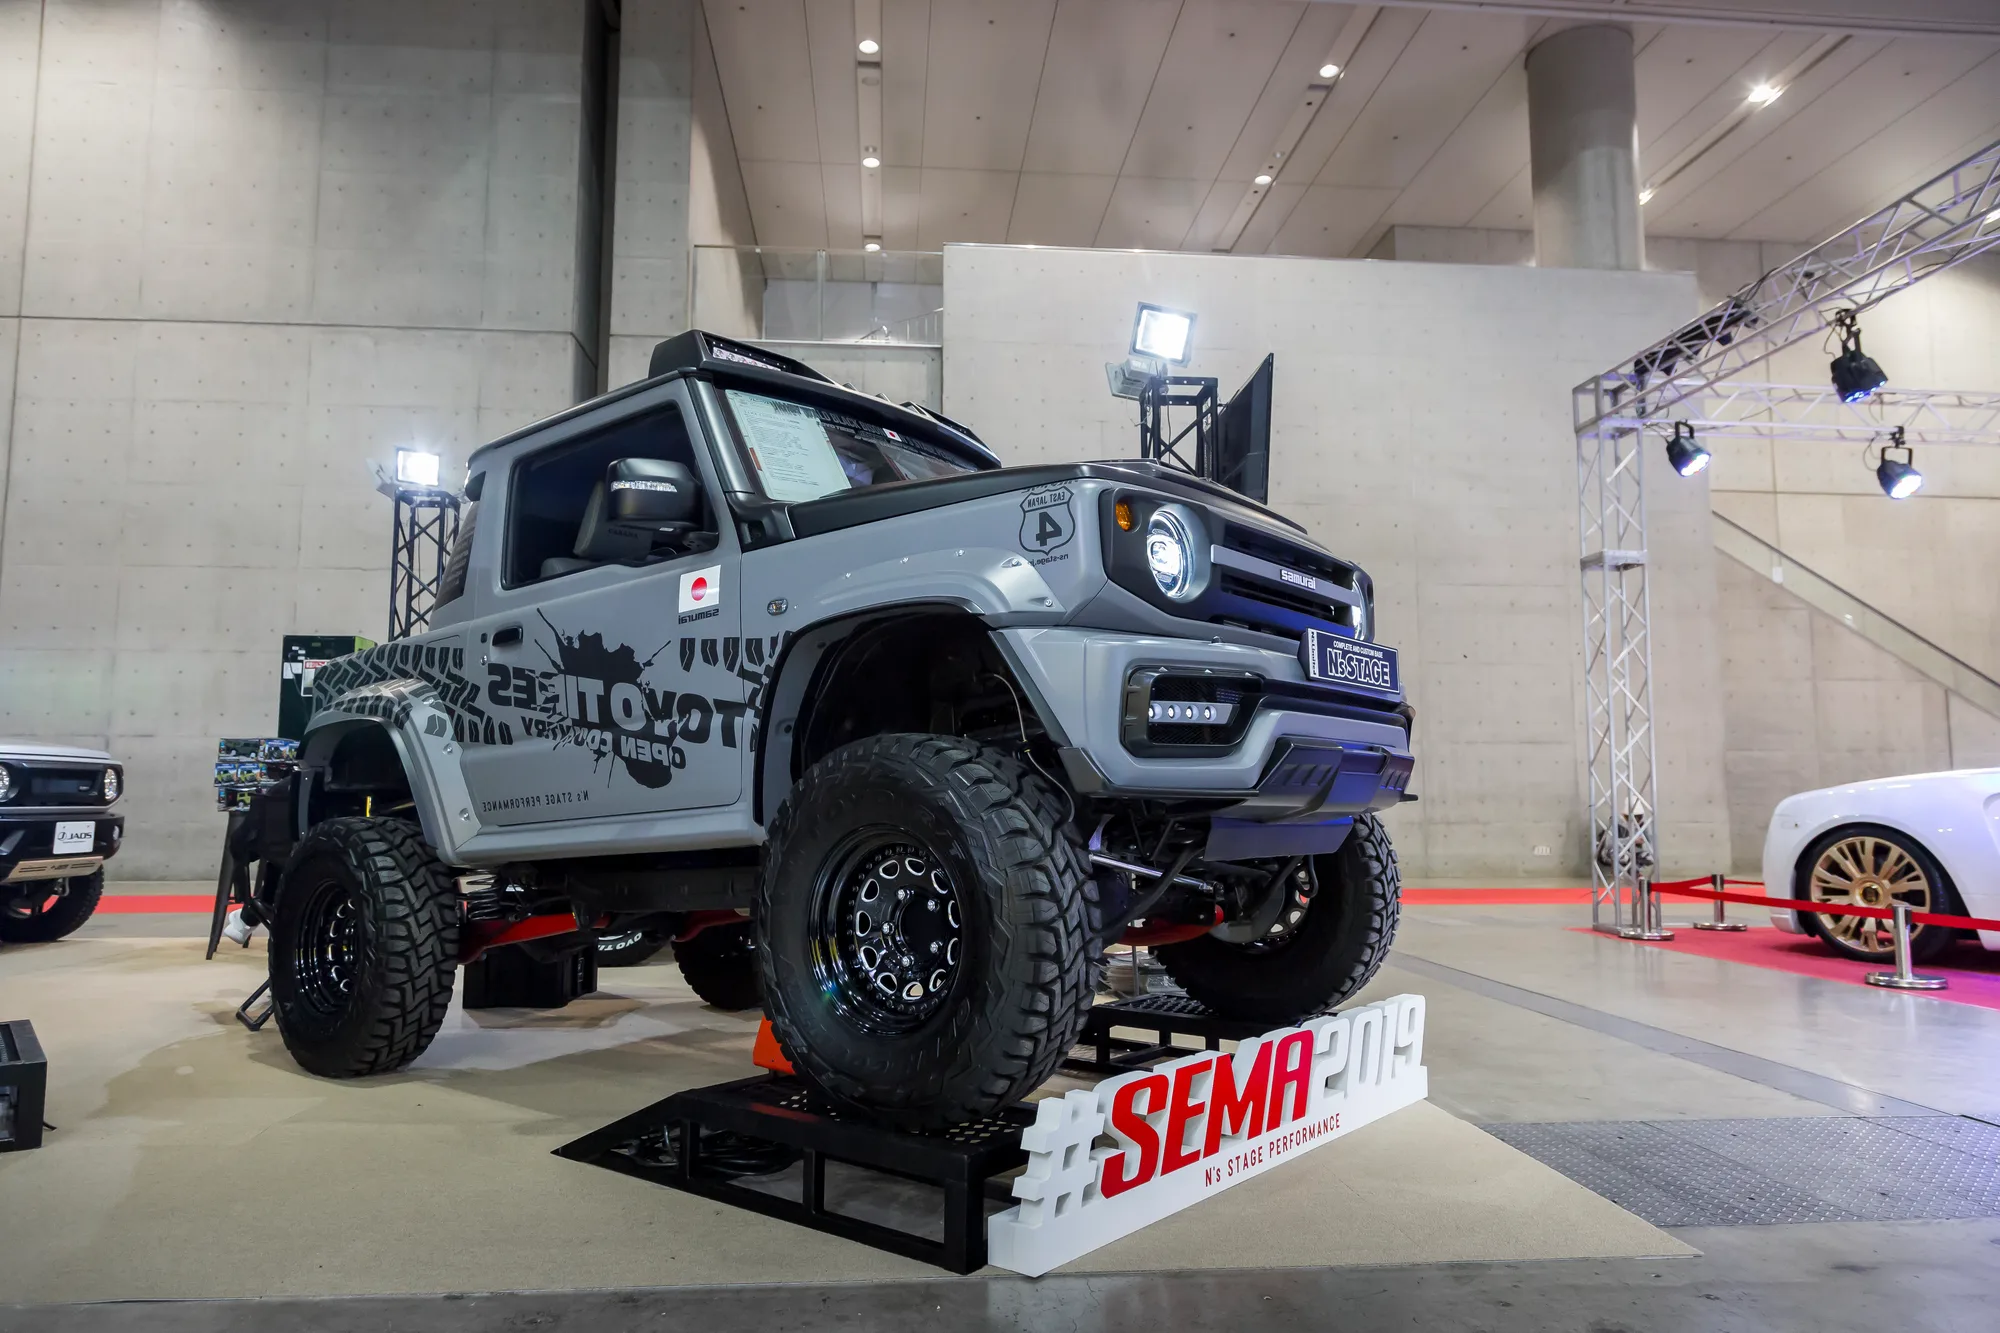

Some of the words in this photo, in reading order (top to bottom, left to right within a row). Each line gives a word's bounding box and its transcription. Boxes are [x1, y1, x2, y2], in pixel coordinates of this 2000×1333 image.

[830, 412, 861, 429] BLACK
[1281, 569, 1316, 590] samurai
[1333, 640, 1352, 652] COMPLETE
[67, 831, 93, 841] JAOS
[1205, 1166, 1221, 1187] N's
[1227, 1146, 1263, 1177] STAGE
[1269, 1112, 1340, 1159] PERFORMANCE
